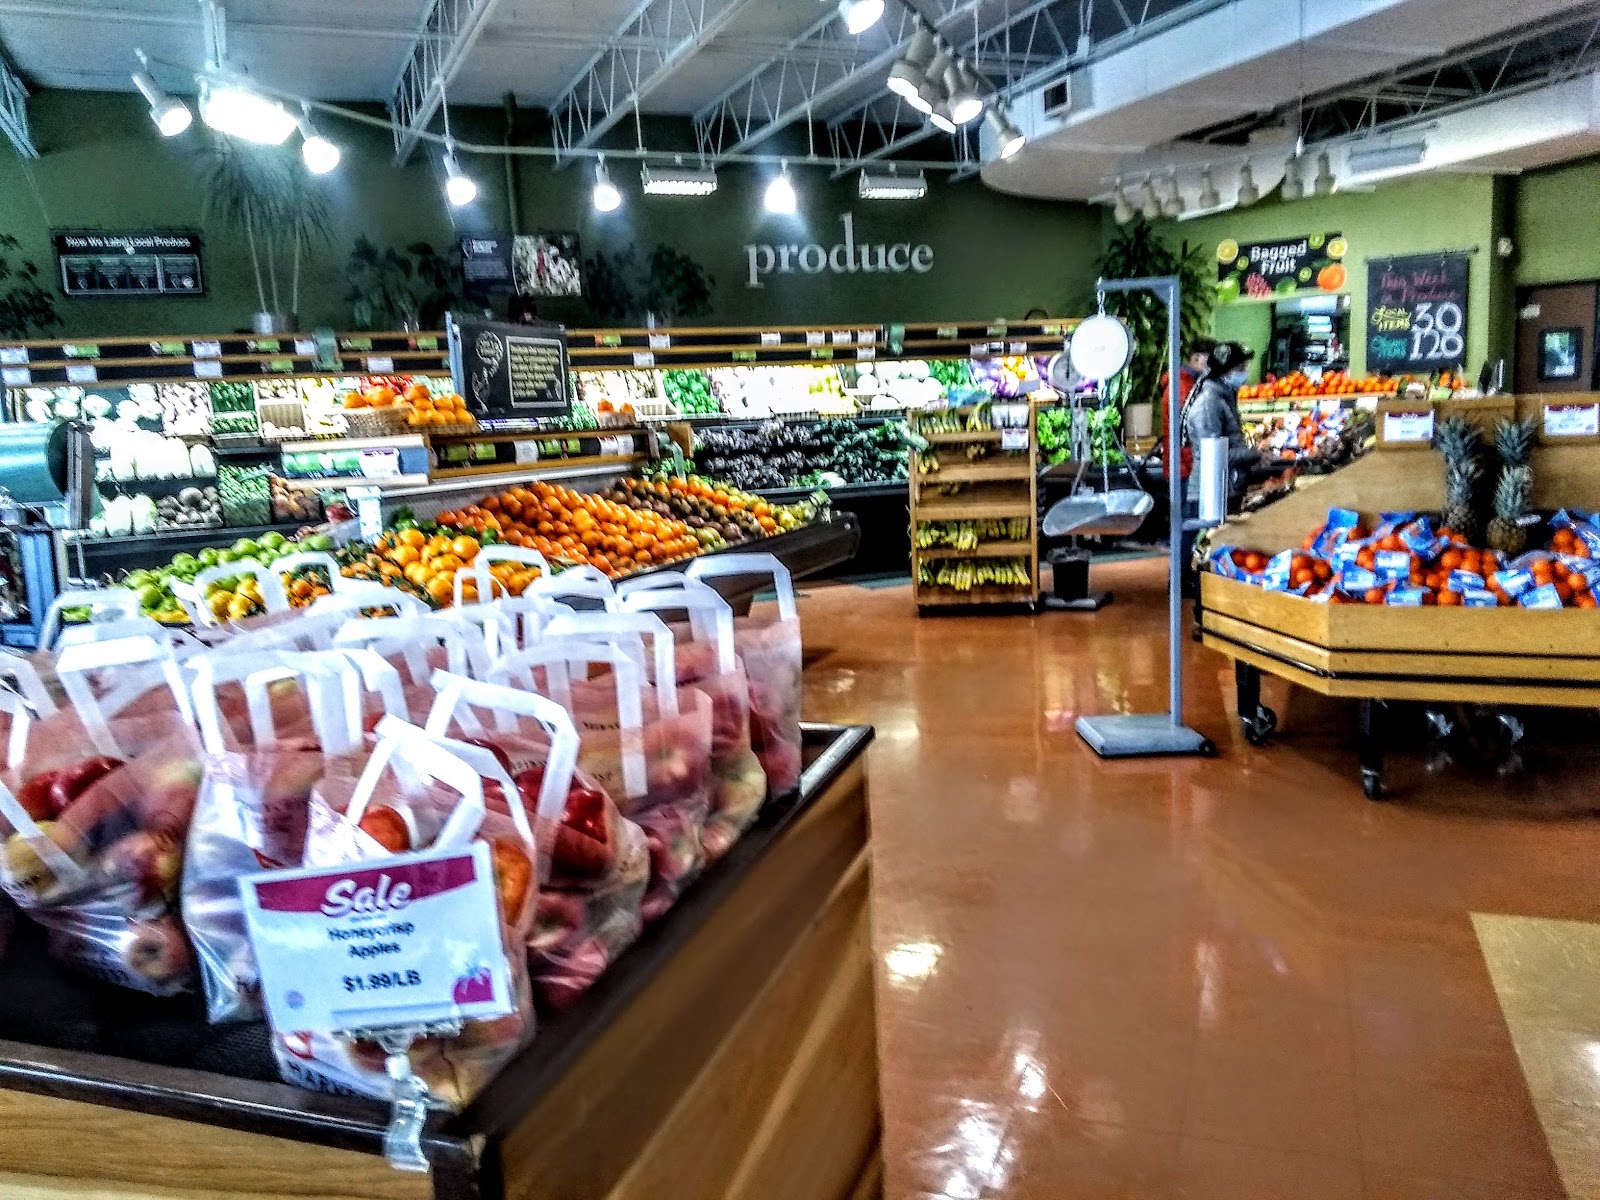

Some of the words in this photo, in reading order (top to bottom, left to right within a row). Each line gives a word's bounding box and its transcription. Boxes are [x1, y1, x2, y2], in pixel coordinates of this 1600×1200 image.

[128, 236, 154, 248] Local
[153, 235, 191, 248] Produce
[743, 212, 934, 289] produce
[1250, 239, 1307, 262] Bagged
[1261, 258, 1297, 276] Fruit
[1415, 301, 1462, 337] 30
[320, 874, 412, 917] Sale
[327, 921, 416, 941] Honeycrisp
[348, 941, 401, 960] Apples
[342, 969, 422, 993] $1.99/LB
